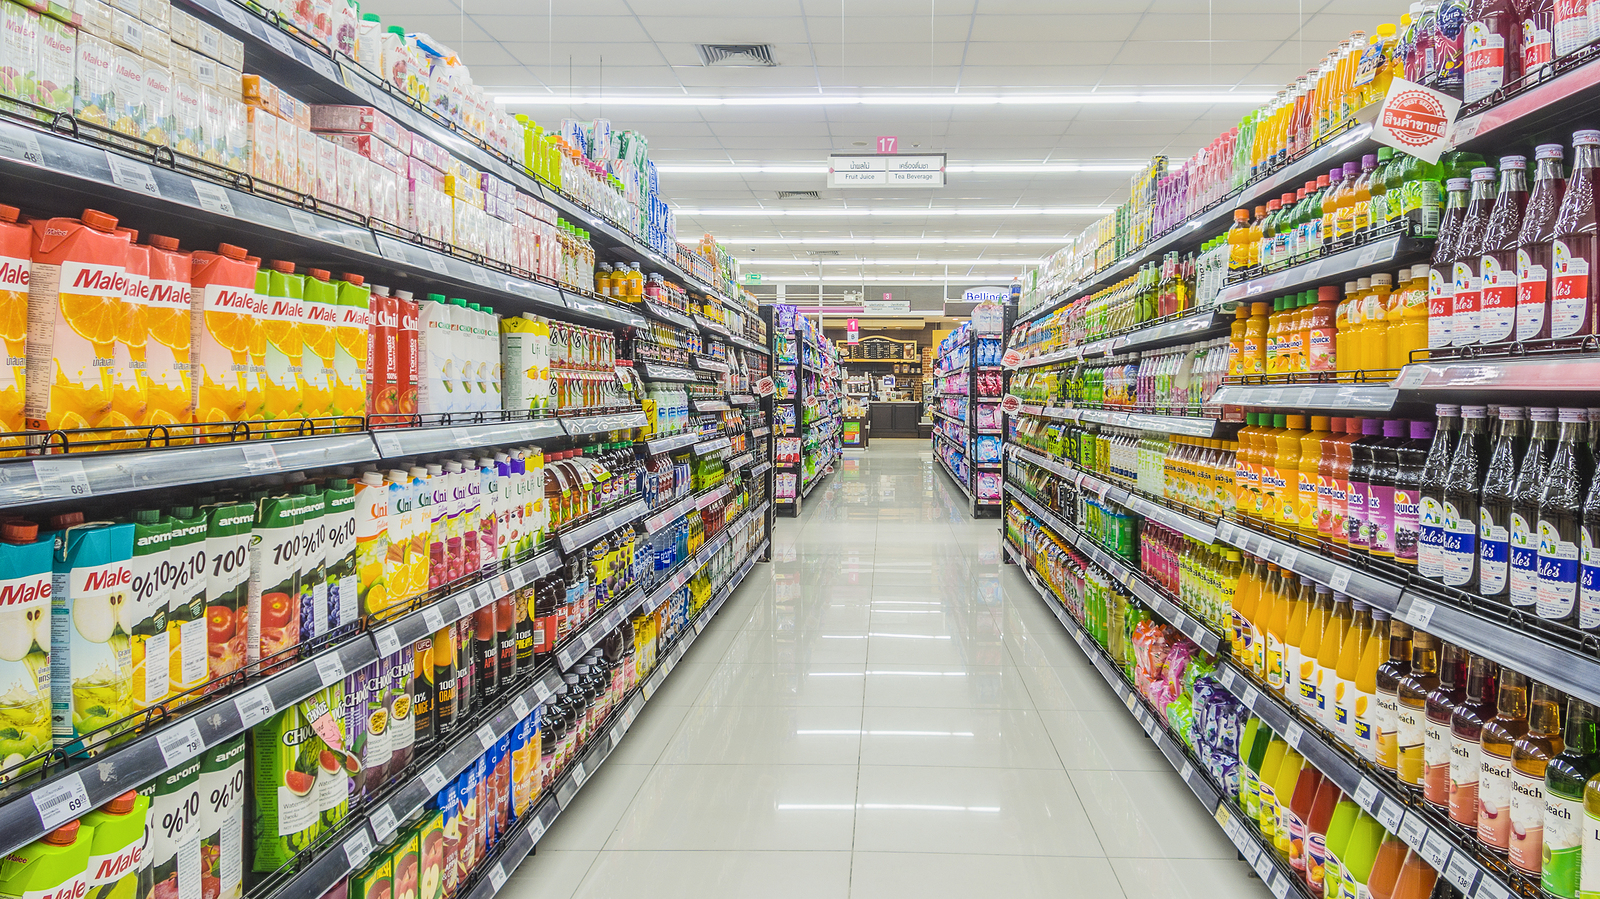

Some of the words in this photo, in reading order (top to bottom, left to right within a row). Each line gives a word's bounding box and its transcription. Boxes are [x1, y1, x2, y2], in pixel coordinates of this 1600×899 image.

[43, 35, 72, 54] Malee
[82, 50, 109, 69] Malee
[116, 64, 141, 82] Malee
[147, 77, 170, 94] Malee
[176, 90, 198, 106] Malee
[1403, 98, 1418, 108] BEST
[1384, 111, 1447, 136] สินค้าขายดี
[879, 138, 895, 152] 17
[850, 321, 855, 330] 1
[572, 331, 581, 348] V8
[83, 566, 131, 592] Male
[418, 641, 431, 650] UFC
[95, 846, 141, 880] Male
